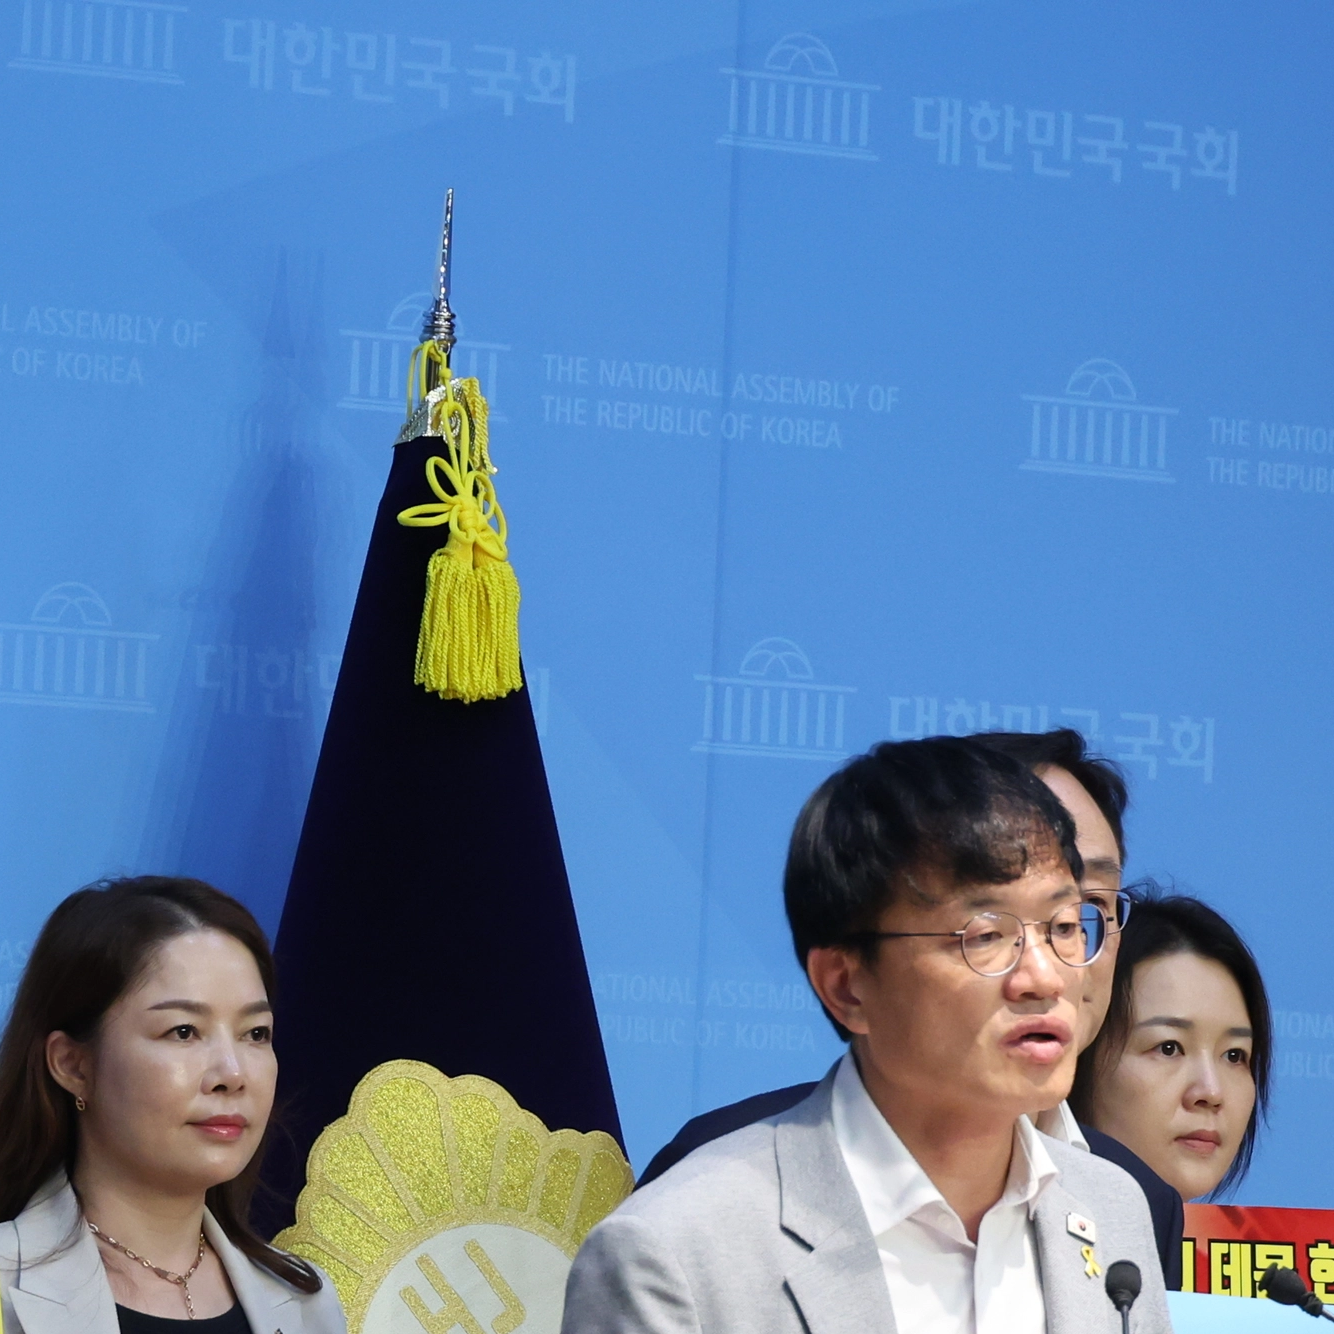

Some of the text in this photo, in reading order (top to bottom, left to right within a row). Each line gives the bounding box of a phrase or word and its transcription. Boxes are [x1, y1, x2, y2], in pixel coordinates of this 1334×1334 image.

[23, 305, 162, 345] ASSEMBLY
[172, 319, 208, 348] OF
[11, 346, 46, 376] OF
[55, 351, 145, 387] KOREA
[542, 353, 900, 414] THE NATIONAL ASSEMBLY OF
[541, 394, 842, 449] THE REPUBLIC OF KOREA
[1208, 415, 1250, 447] THE
[1206, 456, 1249, 487] THE
[698, 1019, 727, 1049] OF
[734, 1022, 816, 1052] KOREA
